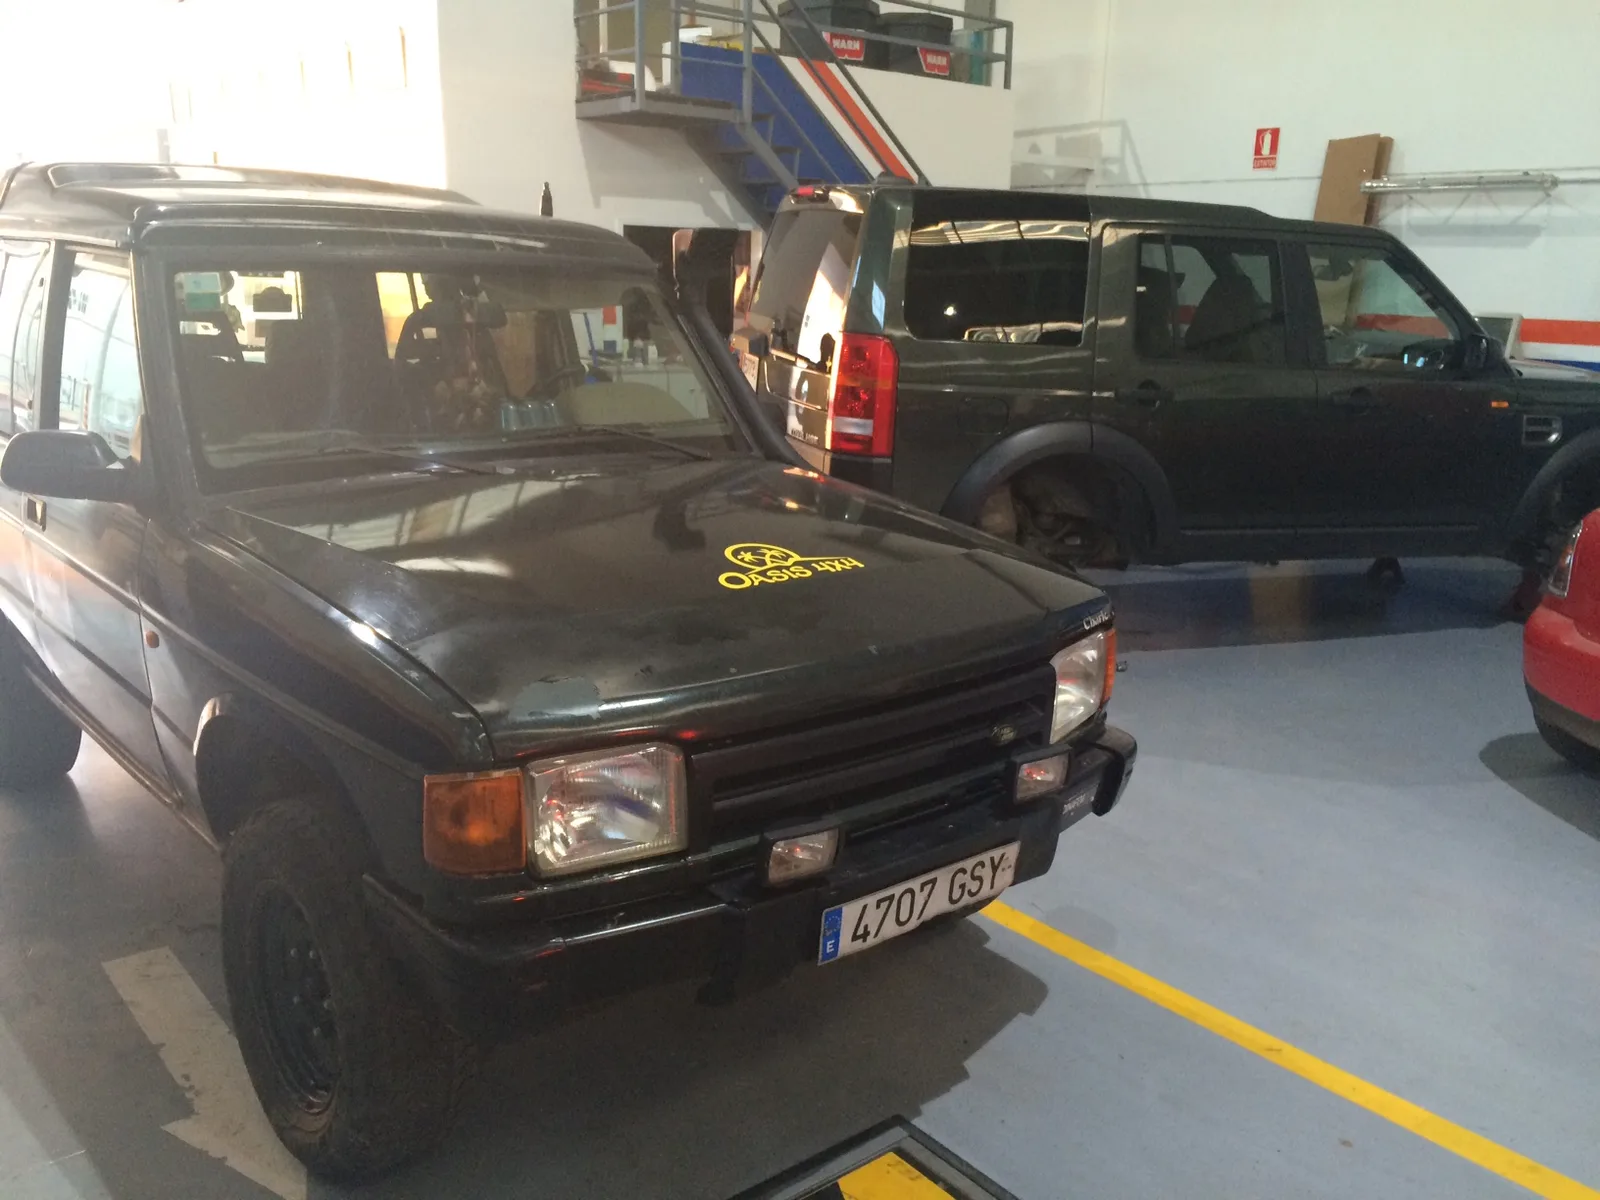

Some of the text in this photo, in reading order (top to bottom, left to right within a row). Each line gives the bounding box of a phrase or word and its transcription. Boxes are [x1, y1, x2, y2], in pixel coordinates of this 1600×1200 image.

[832, 38, 860, 50] WARN
[718, 565, 812, 589] OASIS
[851, 852, 1006, 943] 4707 GSY
[826, 940, 835, 954] E
